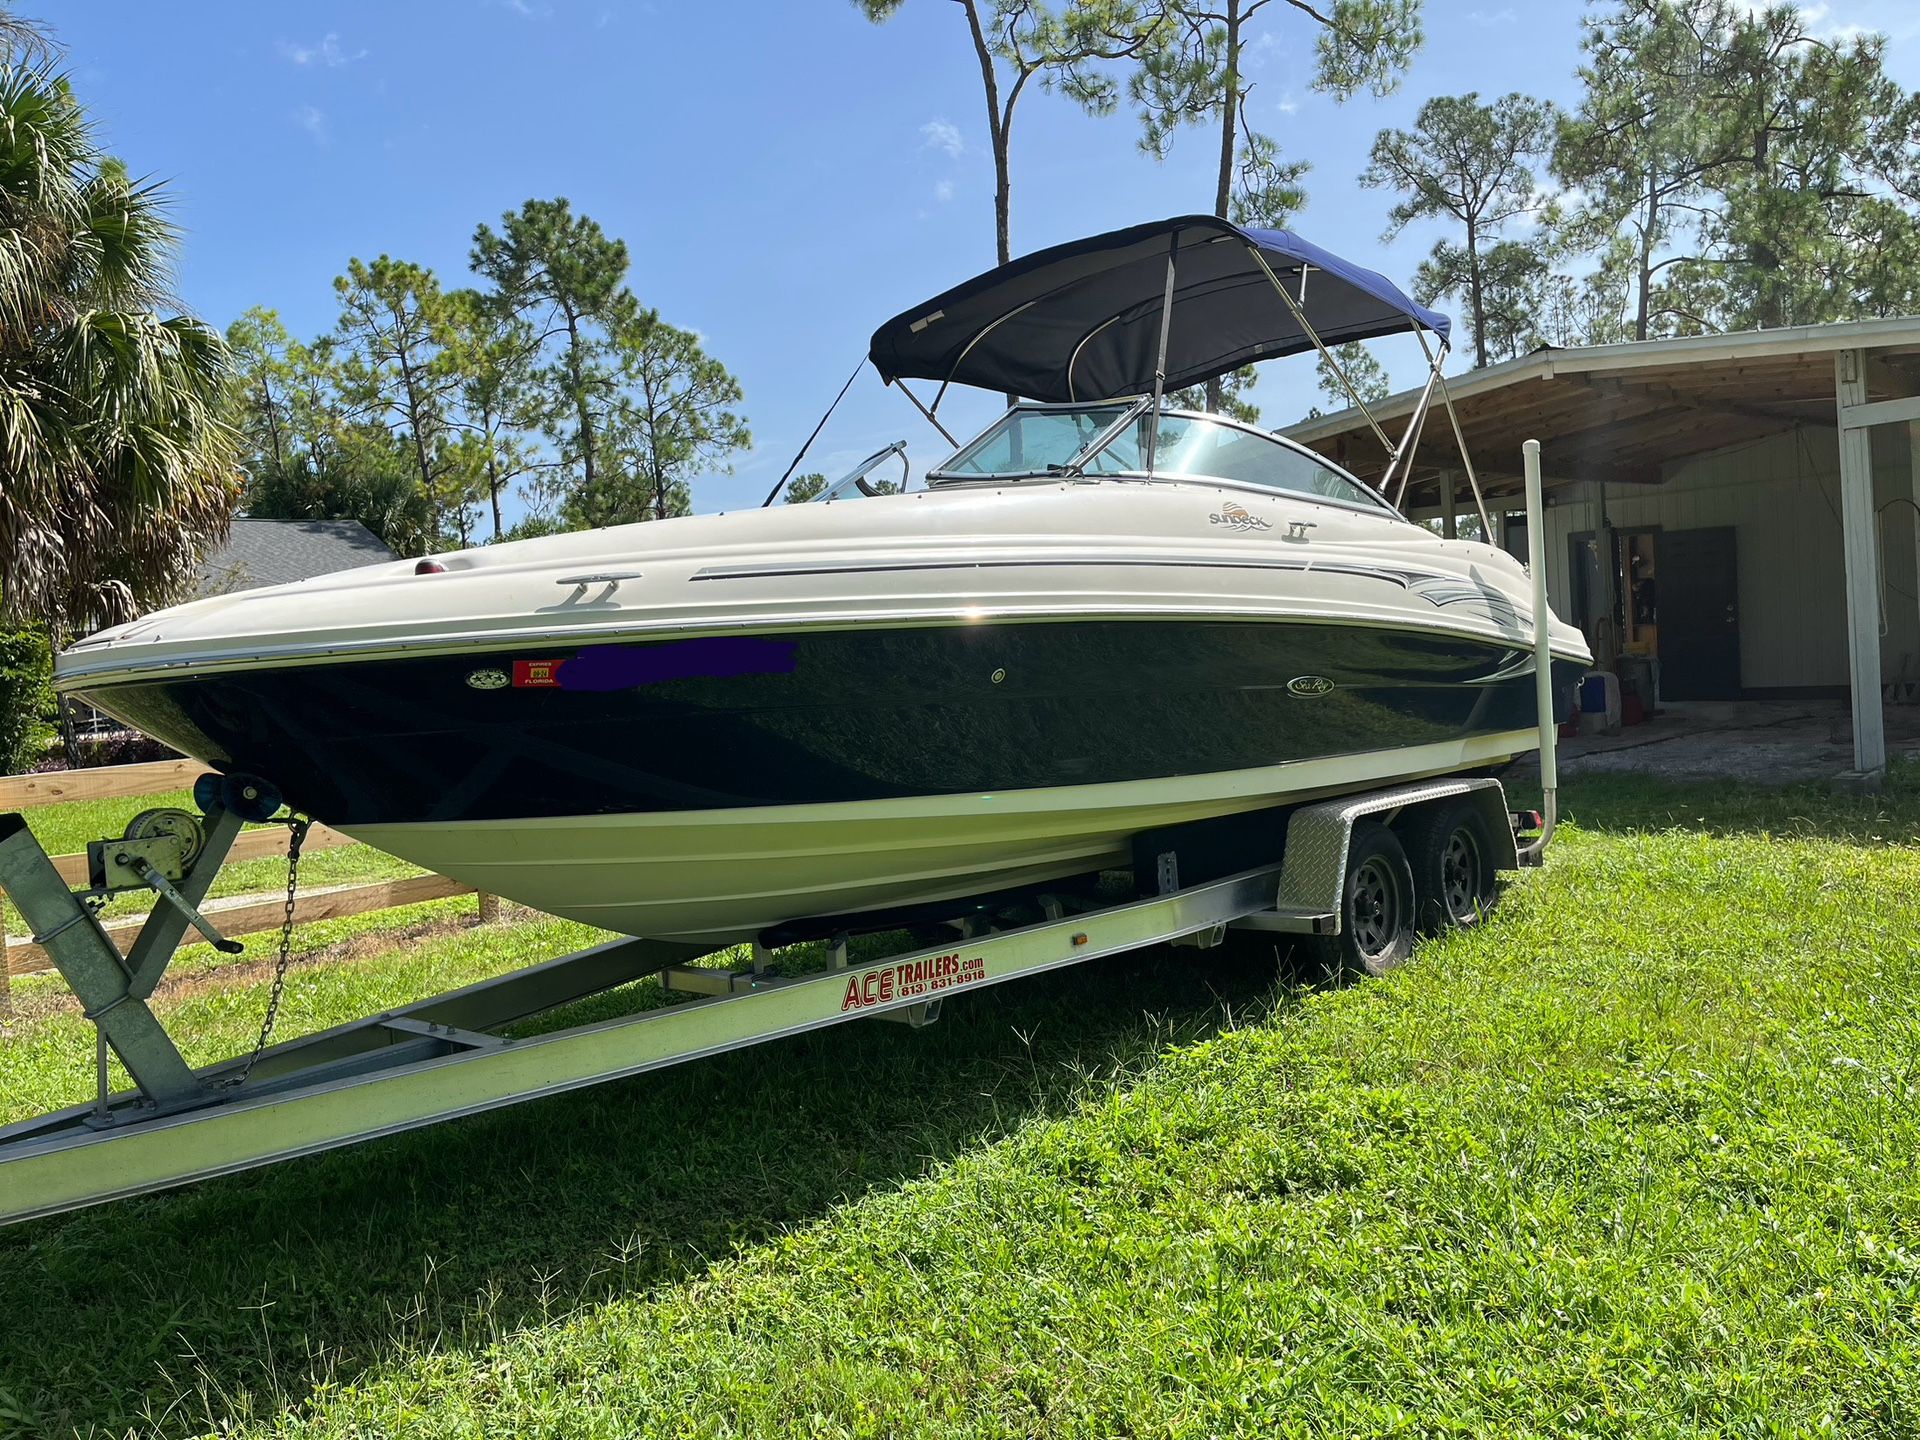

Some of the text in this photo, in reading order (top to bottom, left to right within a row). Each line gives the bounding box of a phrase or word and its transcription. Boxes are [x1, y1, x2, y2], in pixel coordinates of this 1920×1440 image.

[841, 967, 895, 1011] ACE
[896, 970, 985, 998] (813) 831-8918
